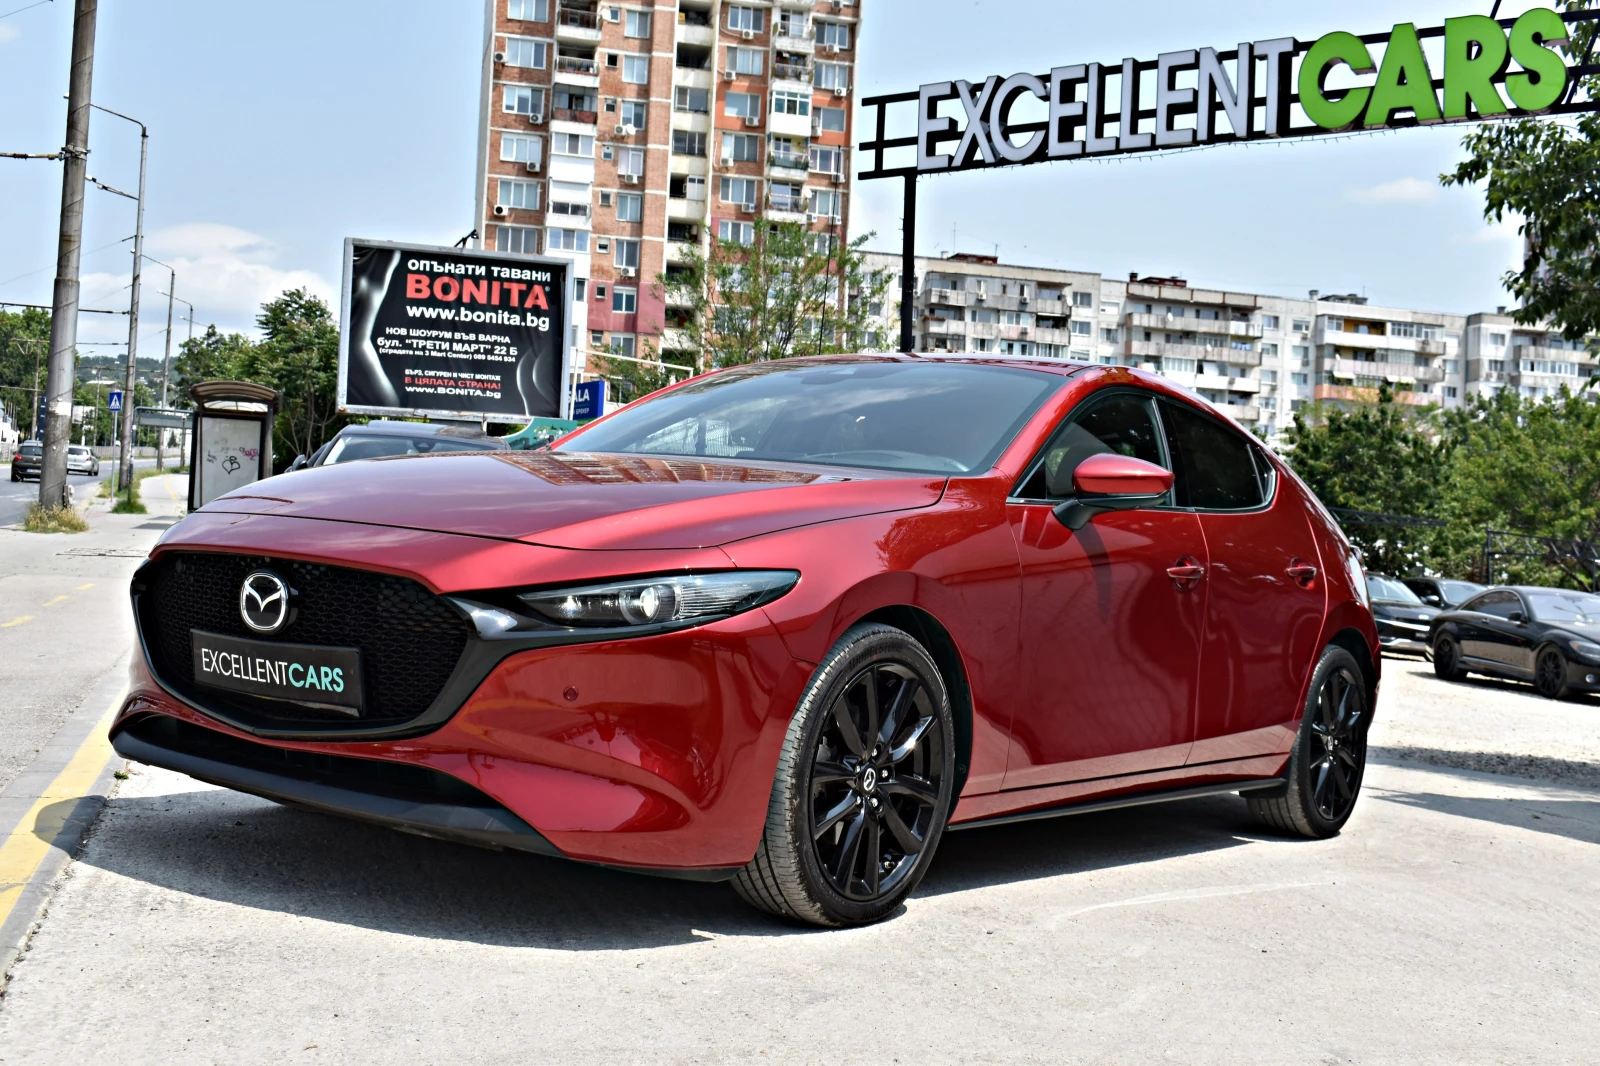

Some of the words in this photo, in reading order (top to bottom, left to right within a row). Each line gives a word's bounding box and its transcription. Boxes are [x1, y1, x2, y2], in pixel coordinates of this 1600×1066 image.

[407, 259, 486, 276] опънати
[491, 266, 551, 282] тавани
[406, 273, 550, 310] BONITA
[406, 305, 550, 331] www.bonita.bg
[385, 327, 407, 336] НОВ
[409, 328, 452, 339] ШОУРУМ
[454, 331, 476, 341] ВЪВ
[478, 333, 511, 343] ВАРНА
[377, 337, 402, 348] бул.
[493, 346, 507, 355] 22
[509, 347, 518, 355] Б
[404, 376, 412, 384] В
[415, 377, 455, 386] ЦЯЛАТА
[458, 380, 501, 389] СТРАНА!
[405, 386, 501, 399] www.BONITA.bg
